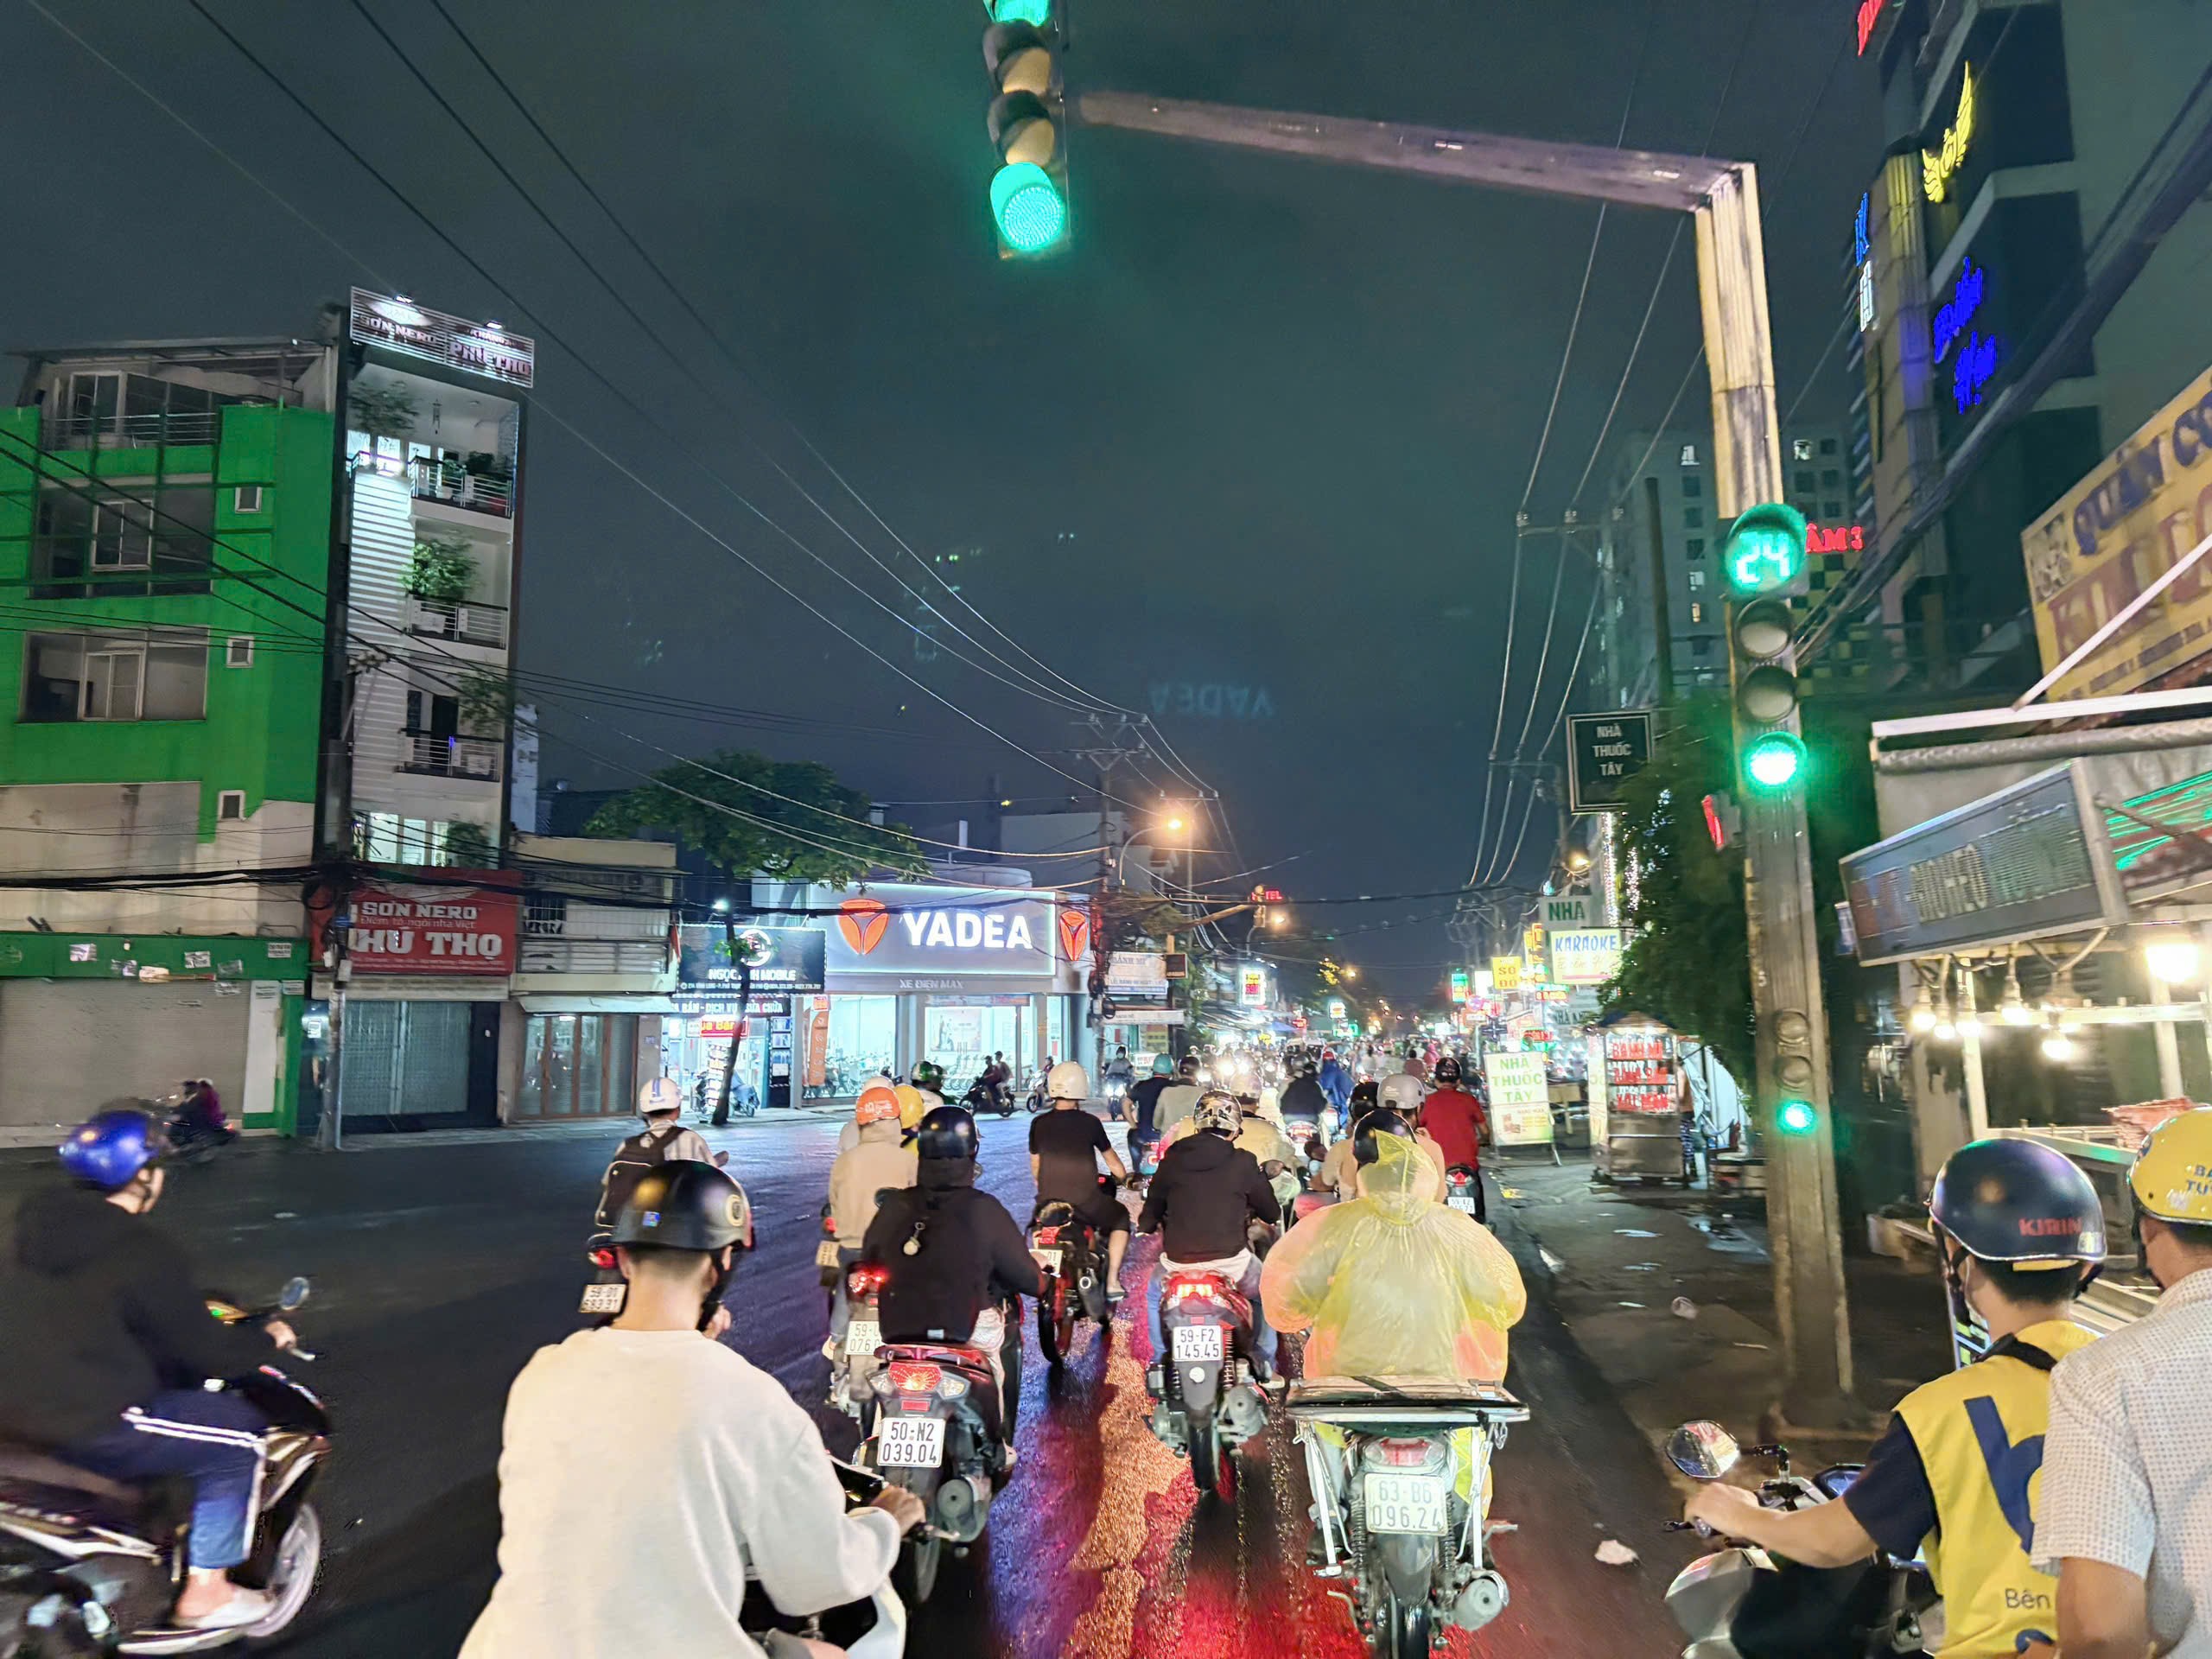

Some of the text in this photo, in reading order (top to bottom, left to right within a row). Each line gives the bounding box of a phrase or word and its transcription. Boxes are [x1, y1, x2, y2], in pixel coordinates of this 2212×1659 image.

[1596, 722, 1623, 738] NHÀ
[1591, 741, 1632, 758] THUỐC
[1599, 761, 1624, 776] TÂY
[1251, 890, 1283, 902] HTEL
[361, 901, 478, 920] SƠN NERO
[902, 912, 1033, 950] YADEA
[425, 931, 503, 961] THỌ
[1554, 934, 1618, 954] KARAOKE
[1499, 1054, 1530, 1070] NHÀ
[1491, 1070, 1543, 1087] THUỐC
[1504, 1088, 1535, 1103] TÂY
[2018, 1217, 2083, 1236] KIRIN
[1179, 1328, 1216, 1343] 59-F2
[1176, 1343, 1220, 1359] 145.45
[890, 1421, 935, 1442] 50-N2
[882, 1443, 938, 1464] 039.04
[1371, 1505, 1440, 1529] 096.24
[2005, 1587, 2051, 1610] Bên
